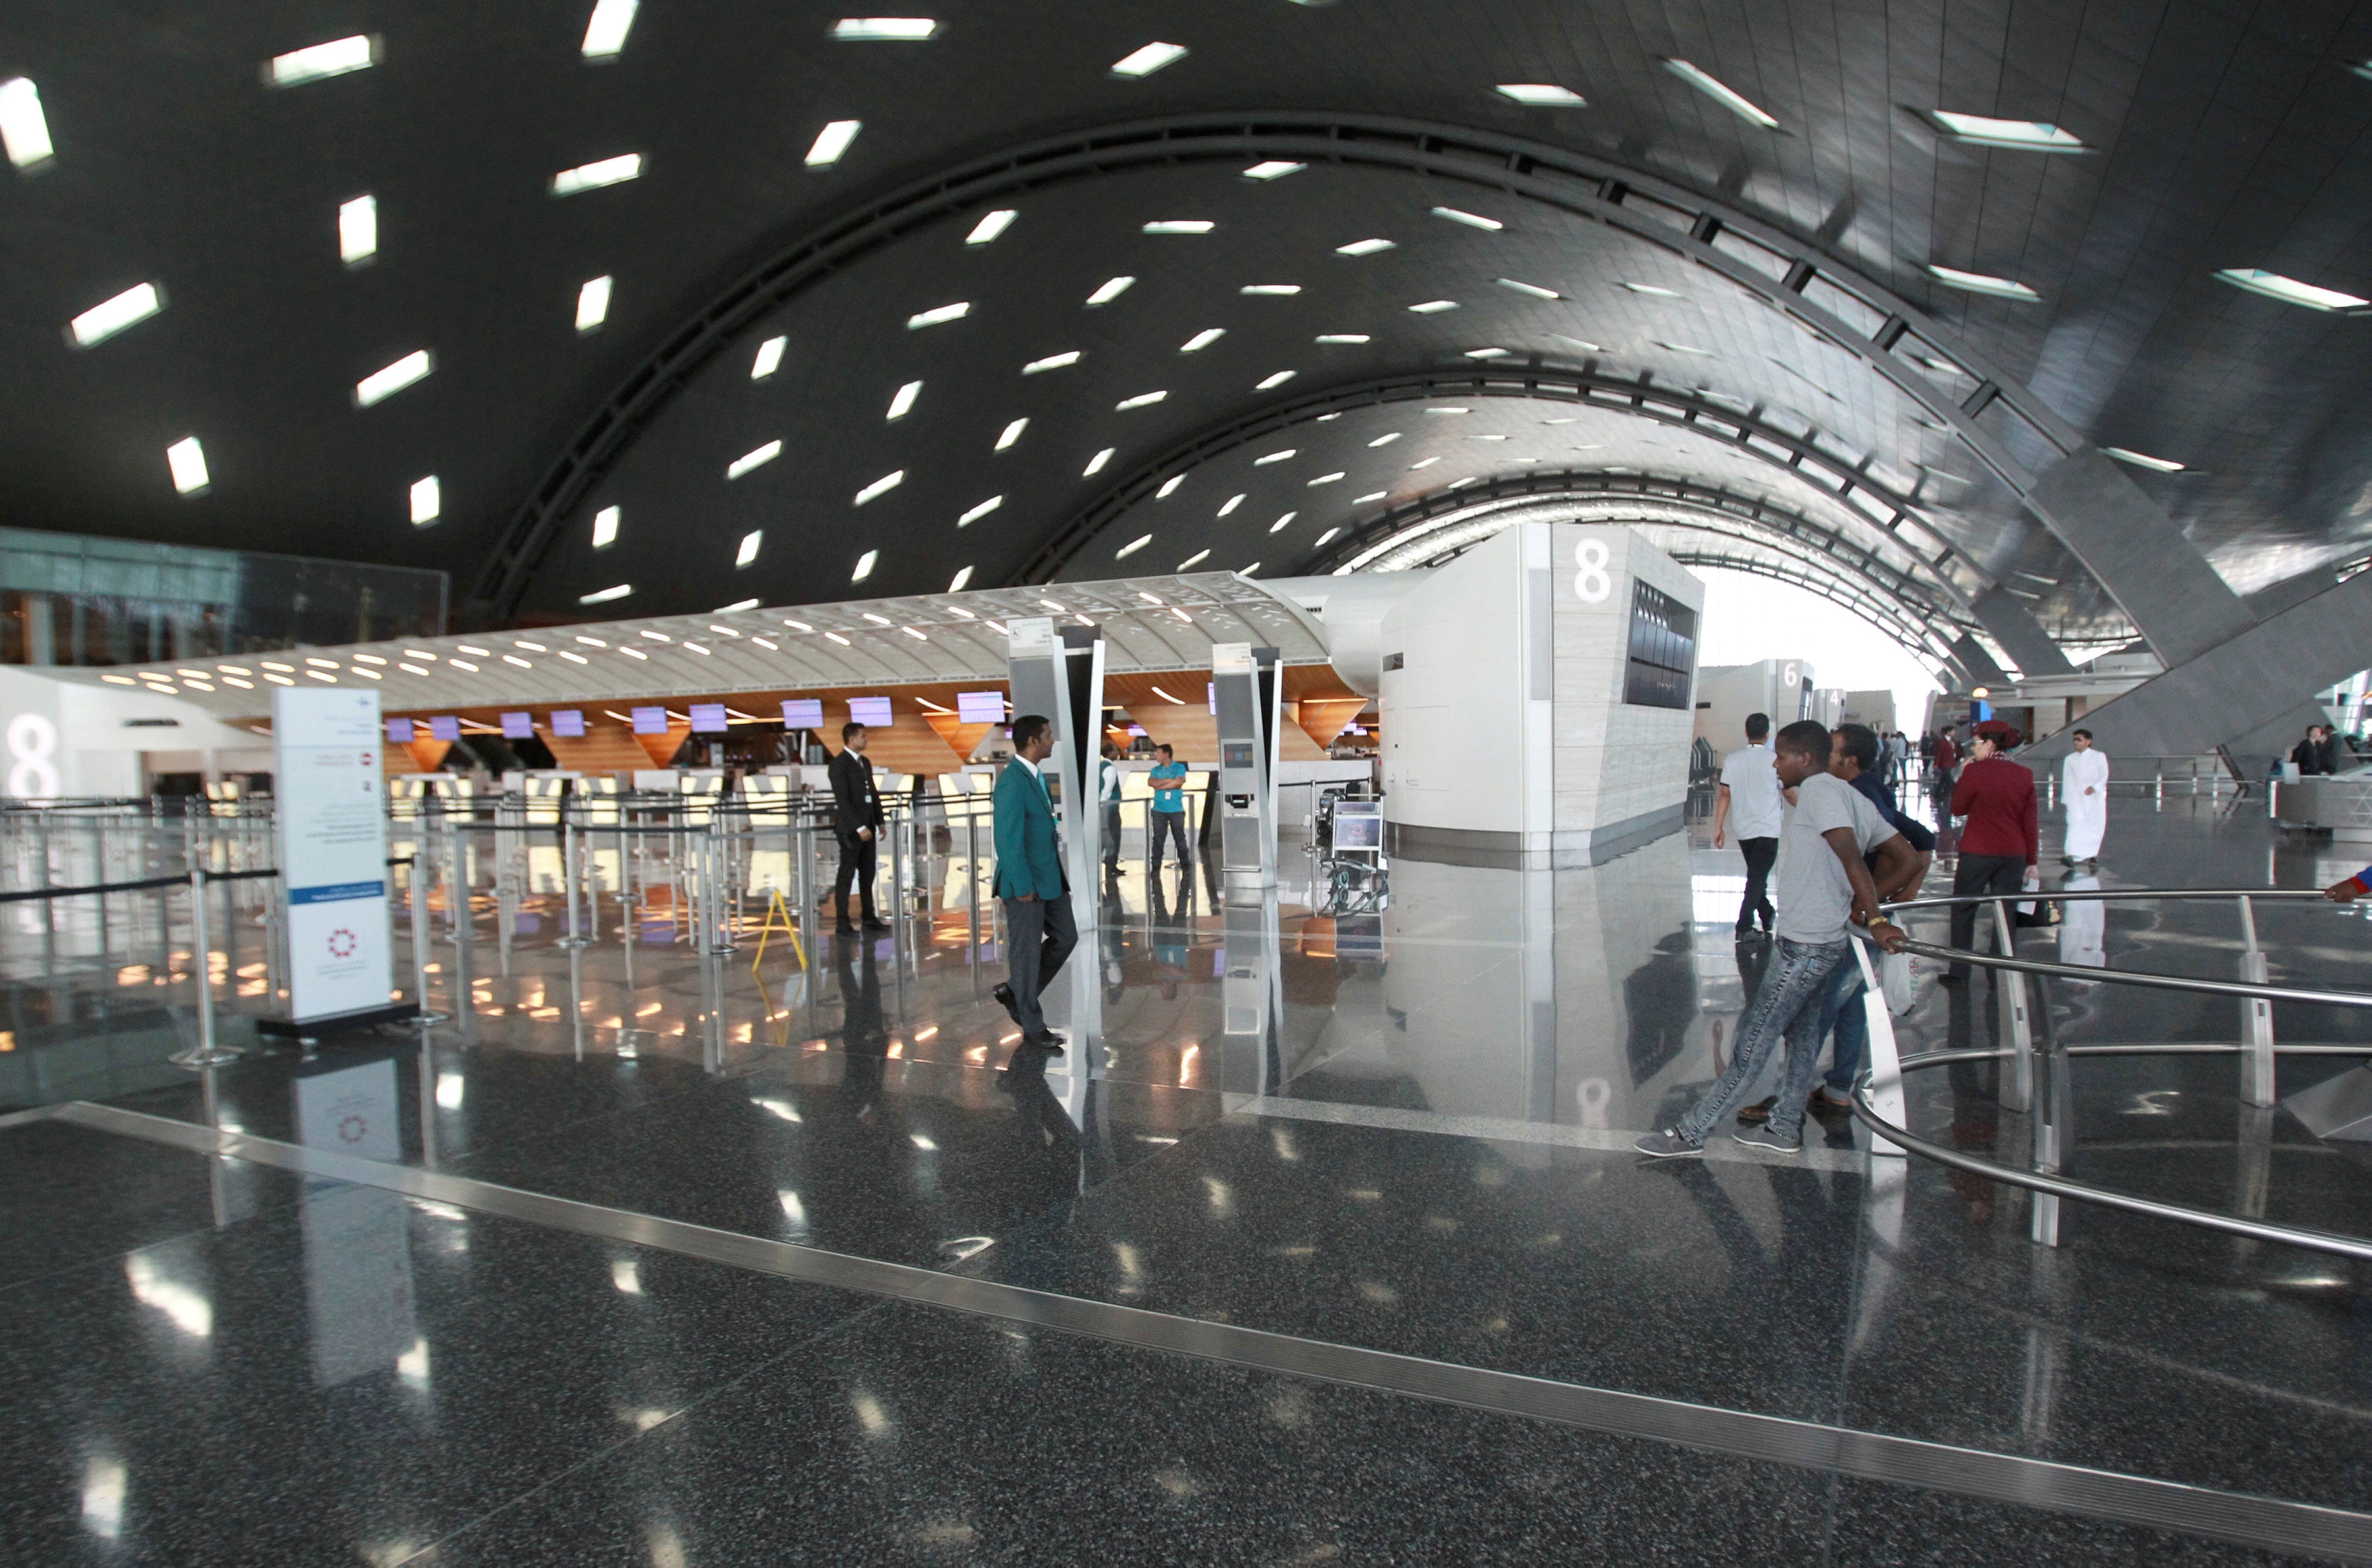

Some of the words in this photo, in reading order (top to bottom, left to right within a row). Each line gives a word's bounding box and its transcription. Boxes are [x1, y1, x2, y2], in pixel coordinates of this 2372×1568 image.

[1574, 537, 1612, 604] 8
[1784, 663, 1797, 686] 6
[1830, 690, 1839, 705] 4
[7, 713, 60, 808] 8
